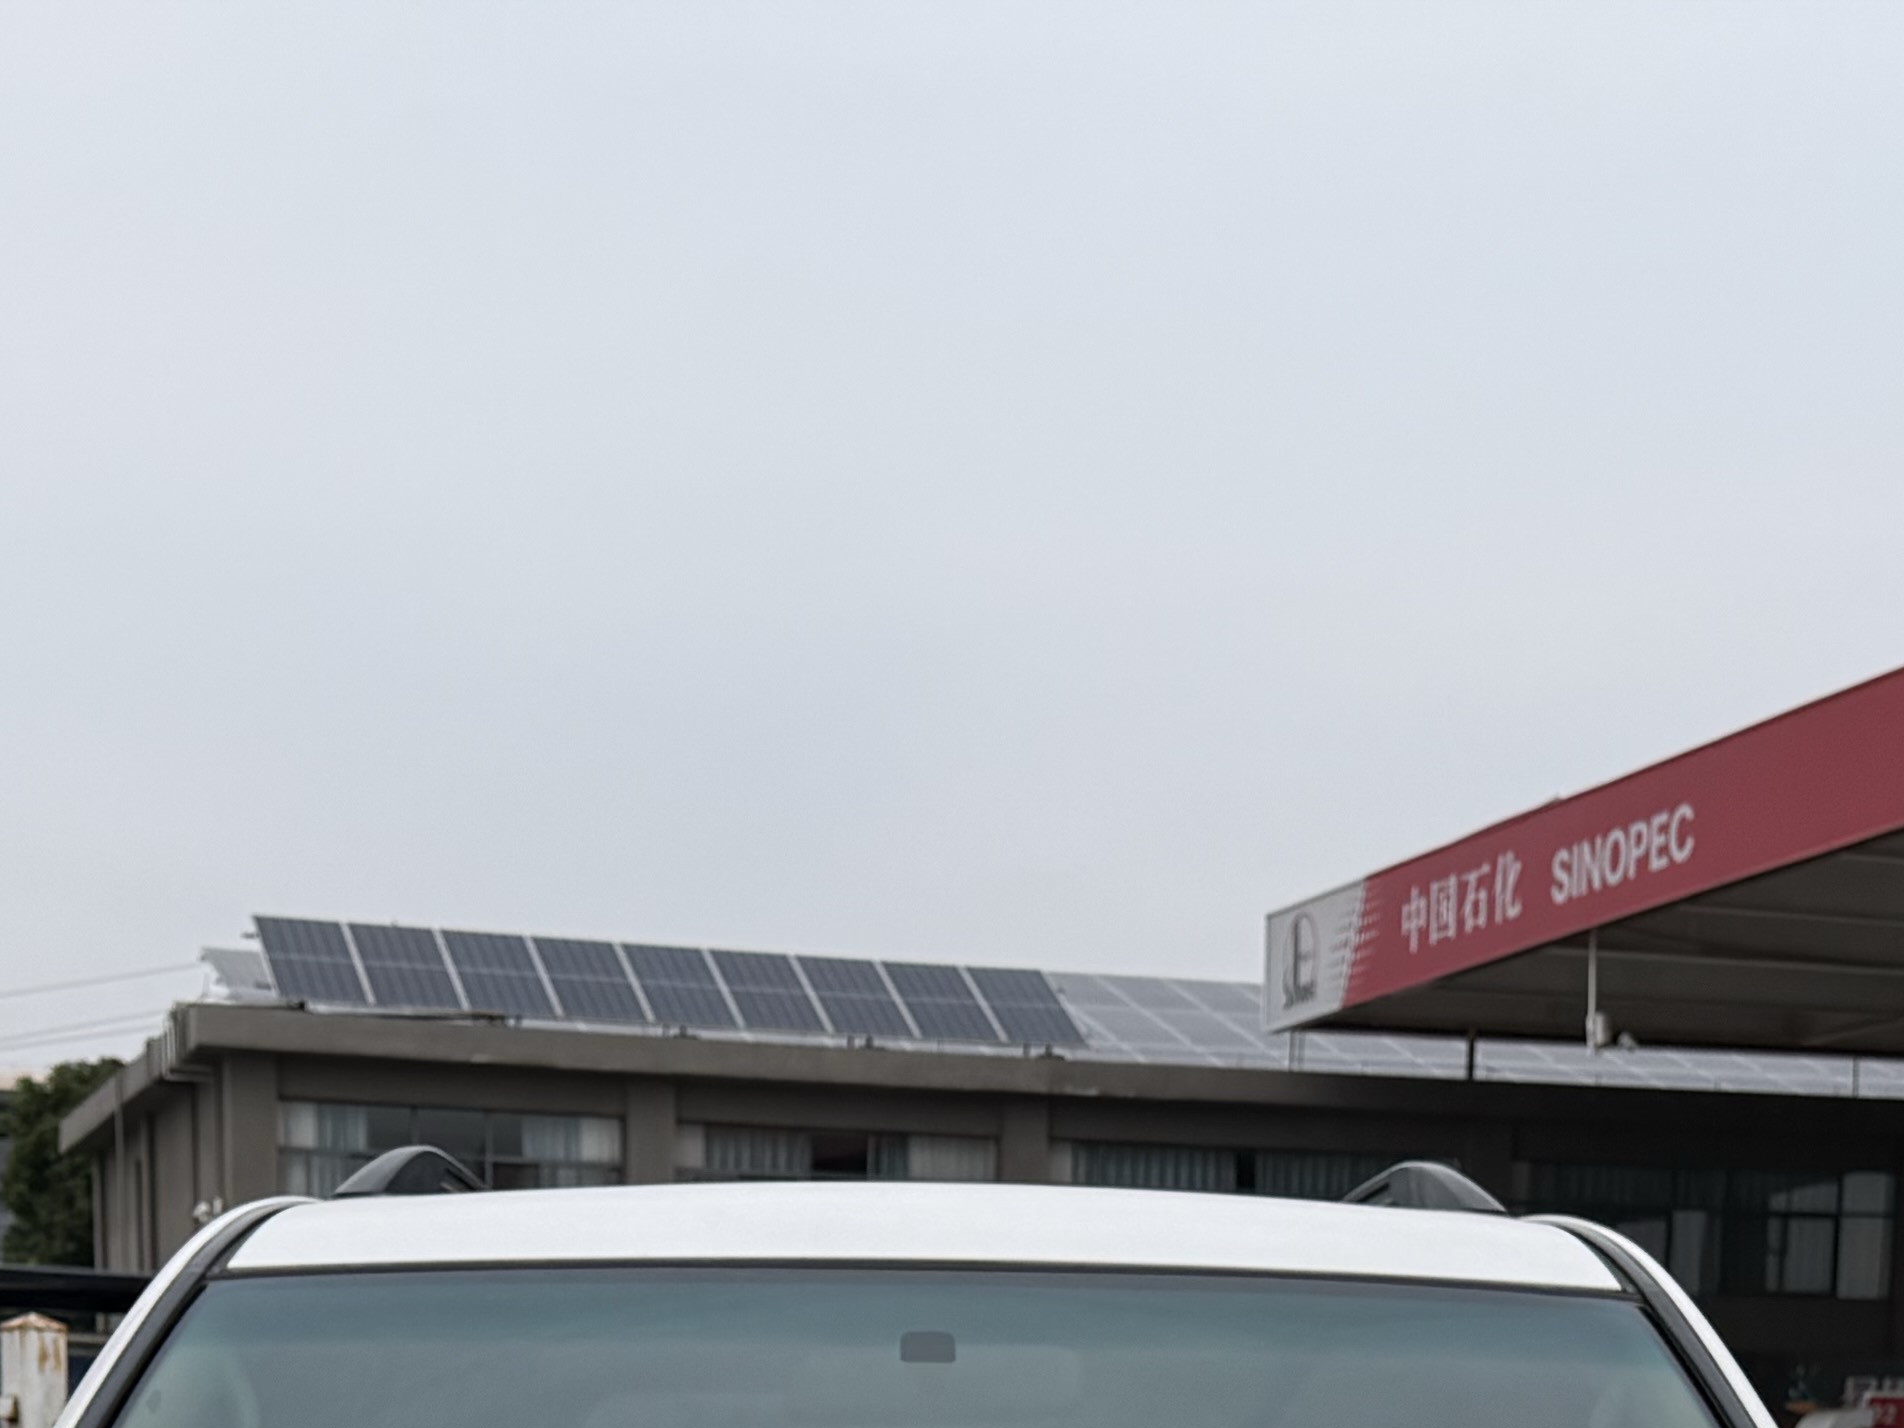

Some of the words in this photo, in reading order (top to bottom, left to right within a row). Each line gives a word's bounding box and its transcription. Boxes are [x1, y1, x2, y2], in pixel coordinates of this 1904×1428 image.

[1401, 850, 1522, 954] 中国石化
[1550, 803, 1695, 905] SINOPEC
